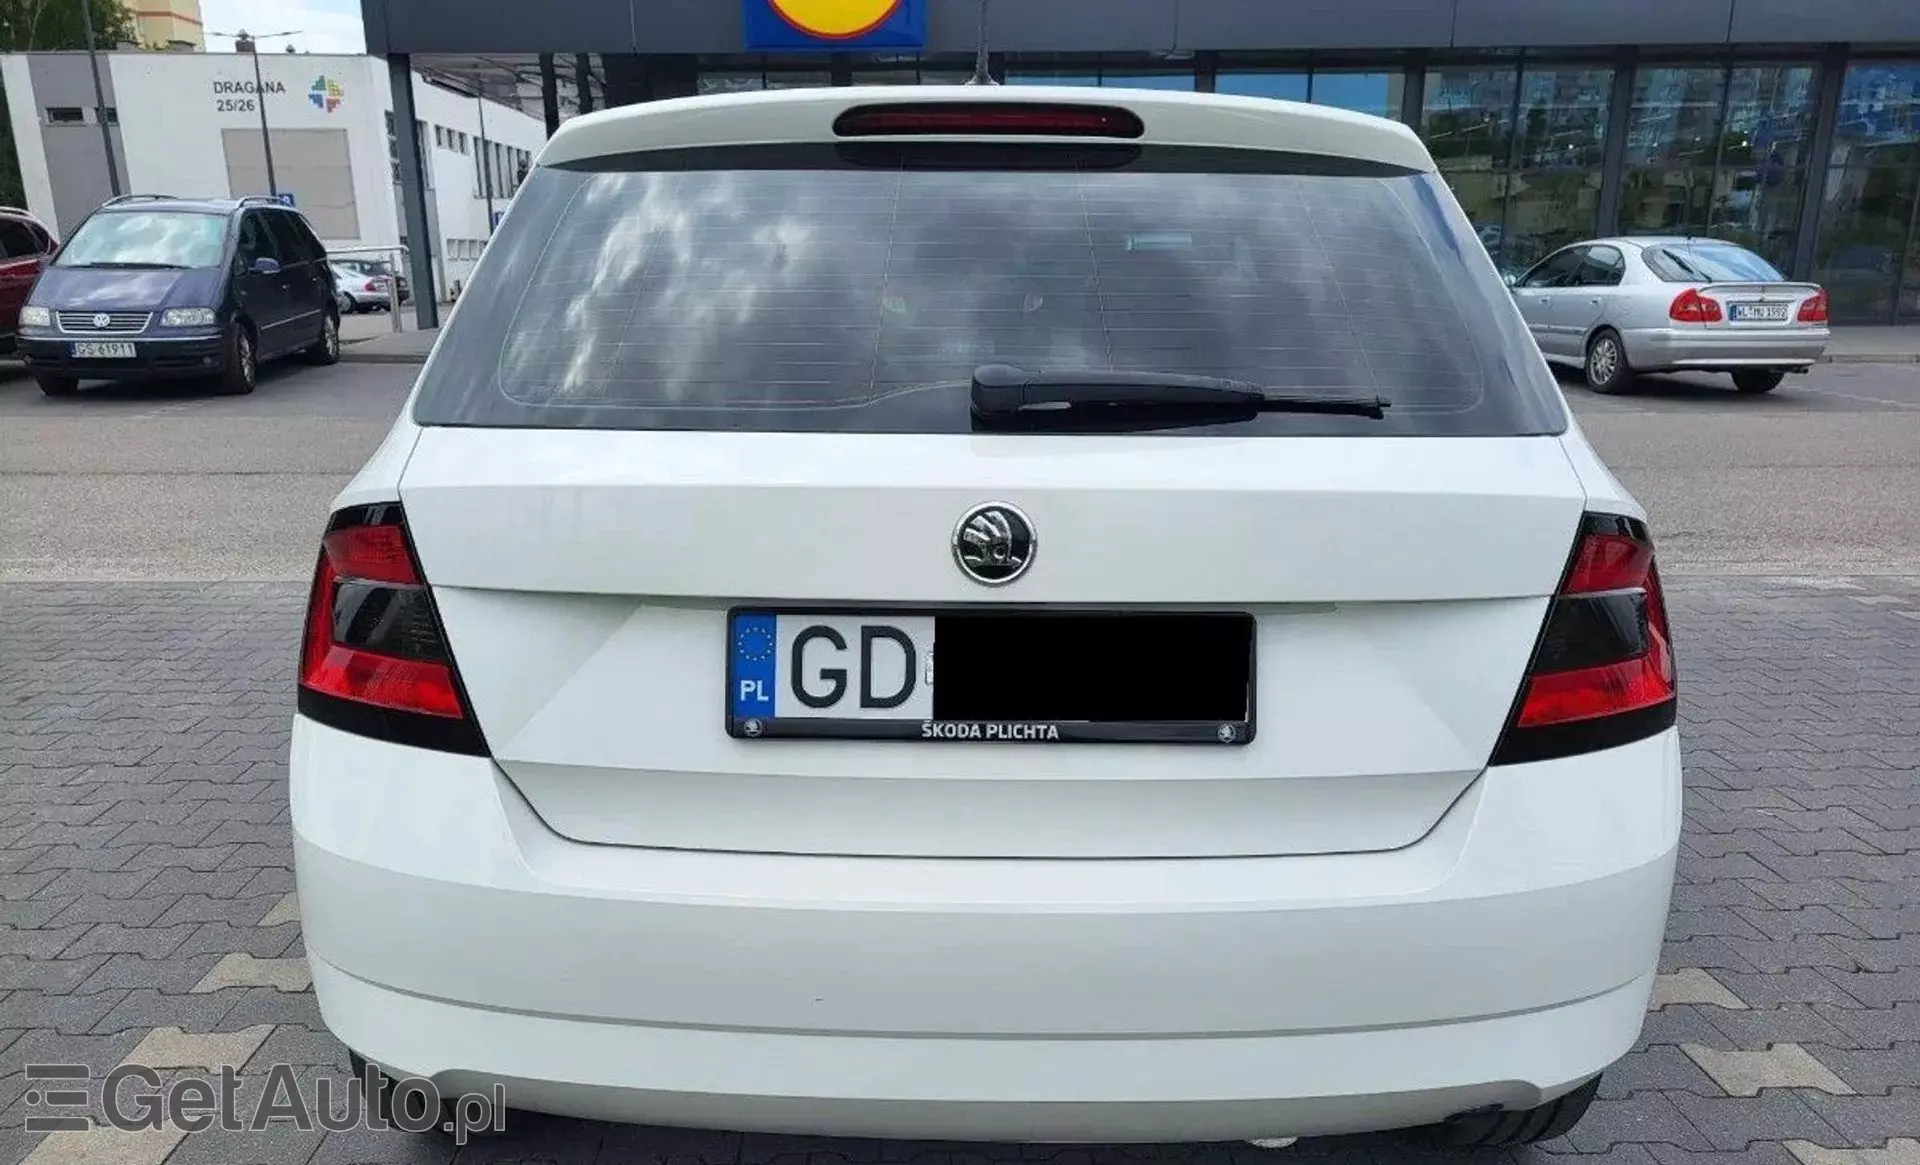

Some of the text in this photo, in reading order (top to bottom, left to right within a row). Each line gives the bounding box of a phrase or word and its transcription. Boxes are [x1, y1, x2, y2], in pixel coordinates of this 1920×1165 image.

[213, 81, 286, 94] DRAGANA
[216, 99, 255, 112] 25/26
[790, 624, 917, 709] GD
[740, 679, 770, 702] PL
[921, 720, 1060, 740] ŠKODA PLICHTA
